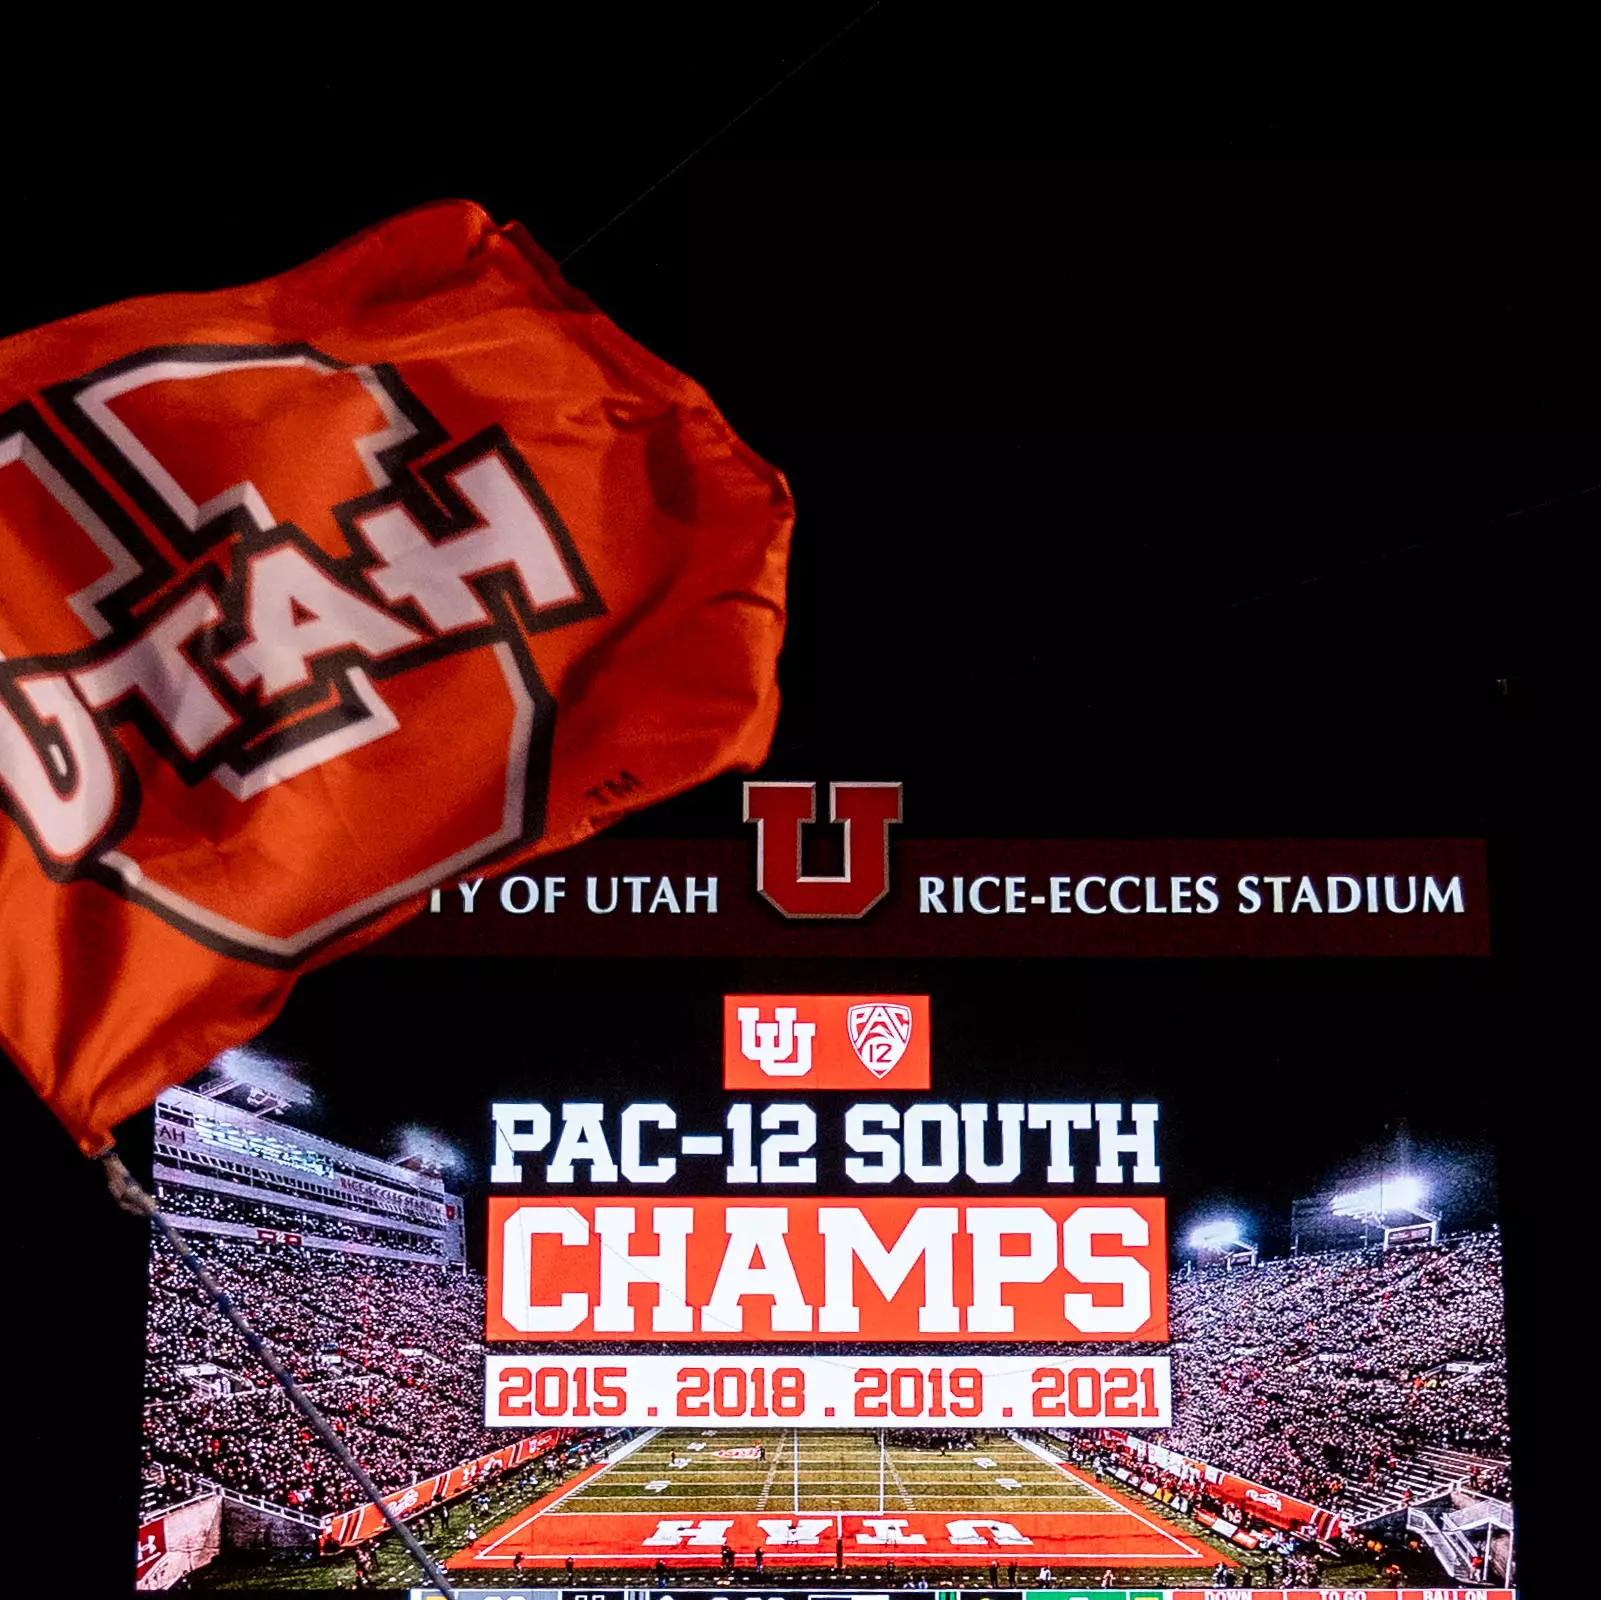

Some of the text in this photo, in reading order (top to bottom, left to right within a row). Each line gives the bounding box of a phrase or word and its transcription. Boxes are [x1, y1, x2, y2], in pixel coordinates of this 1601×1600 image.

[744, 781, 903, 919] U
[500, 875, 567, 914] OF
[586, 875, 719, 914] UTAH
[918, 875, 1466, 915] RICE-ECCLES STADIUM
[851, 1005, 912, 1047] PAC
[868, 1043, 893, 1064] 12
[490, 1103, 1162, 1184] PAC-12 SOUTH
[501, 1206, 1152, 1334] CHAMPS
[498, 1366, 628, 1418] 2015
[675, 1367, 806, 1418] 2018
[853, 1367, 985, 1418] 2019
[1030, 1367, 1160, 1418] 2021
